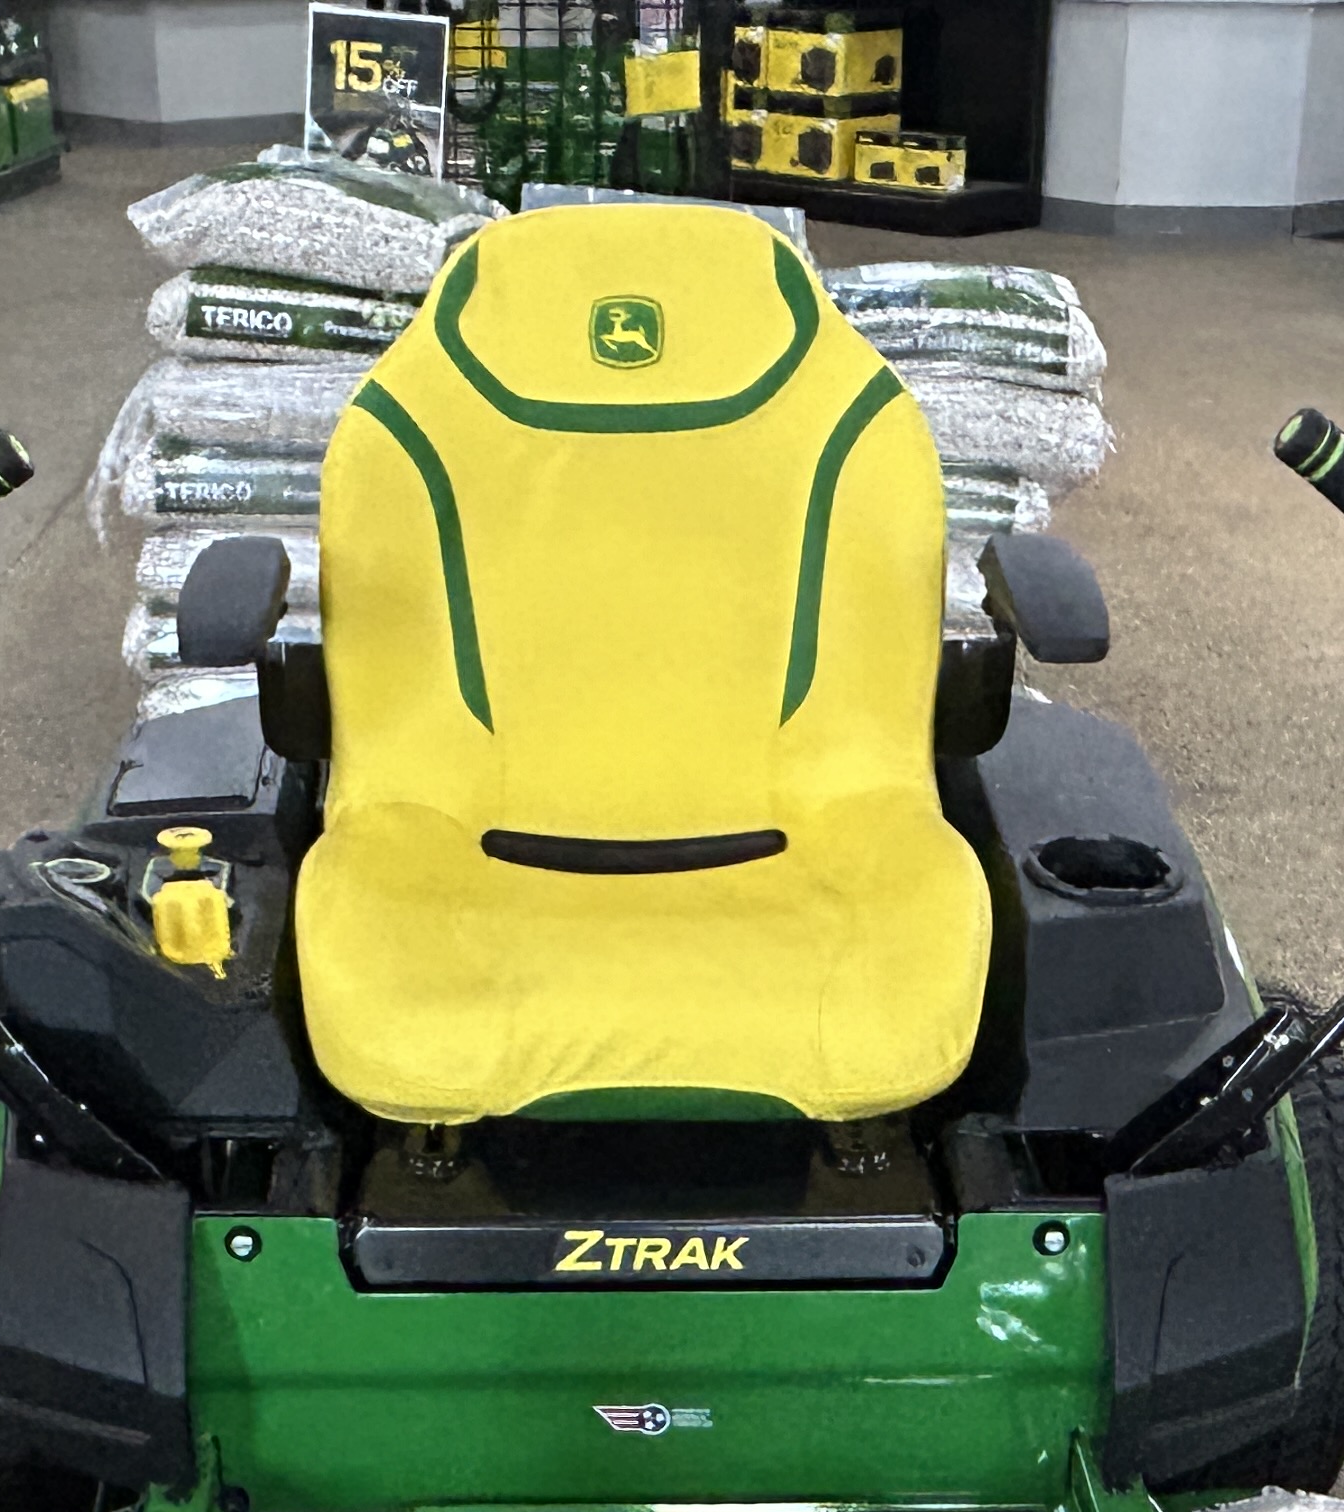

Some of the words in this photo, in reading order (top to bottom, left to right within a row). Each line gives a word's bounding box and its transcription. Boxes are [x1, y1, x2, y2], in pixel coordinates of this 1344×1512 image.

[329, 39, 384, 93] 15
[200, 304, 293, 332] TERICO
[164, 480, 252, 501] TERICO
[554, 1229, 751, 1271] ZTRAK
